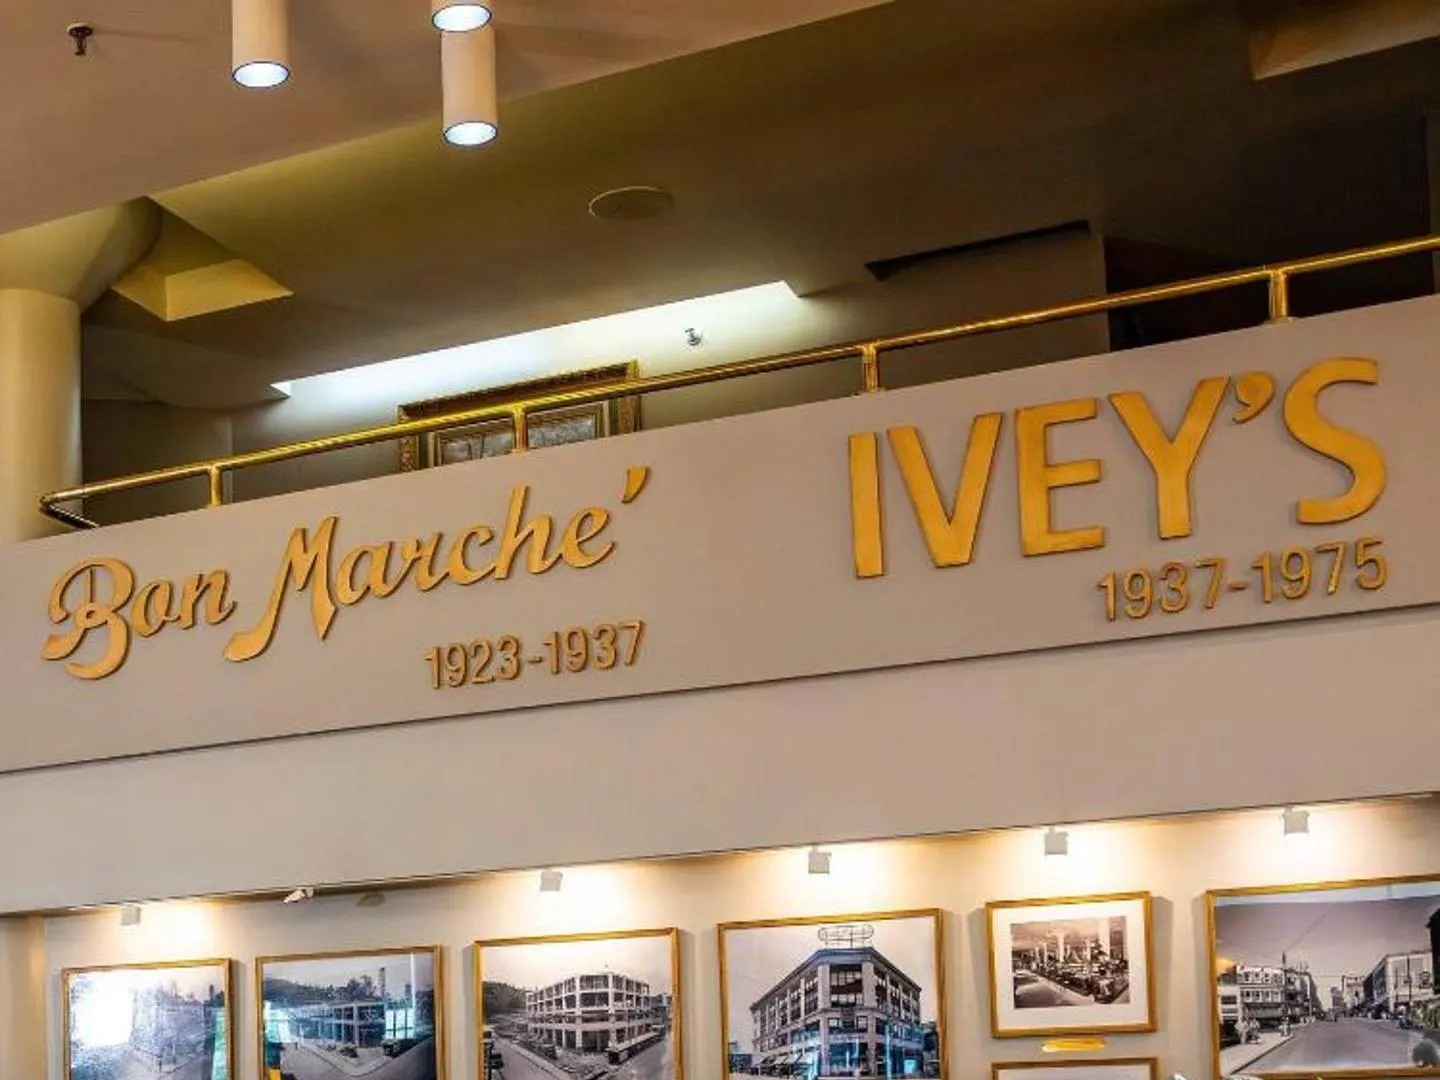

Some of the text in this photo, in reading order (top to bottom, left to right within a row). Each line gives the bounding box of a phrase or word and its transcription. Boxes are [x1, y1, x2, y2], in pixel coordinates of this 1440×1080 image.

[848, 357, 1387, 578] IVEY’S
[42, 556, 236, 679] Bon
[1098, 538, 1389, 622] 1937-1975
[424, 620, 647, 691] 1923-1937
